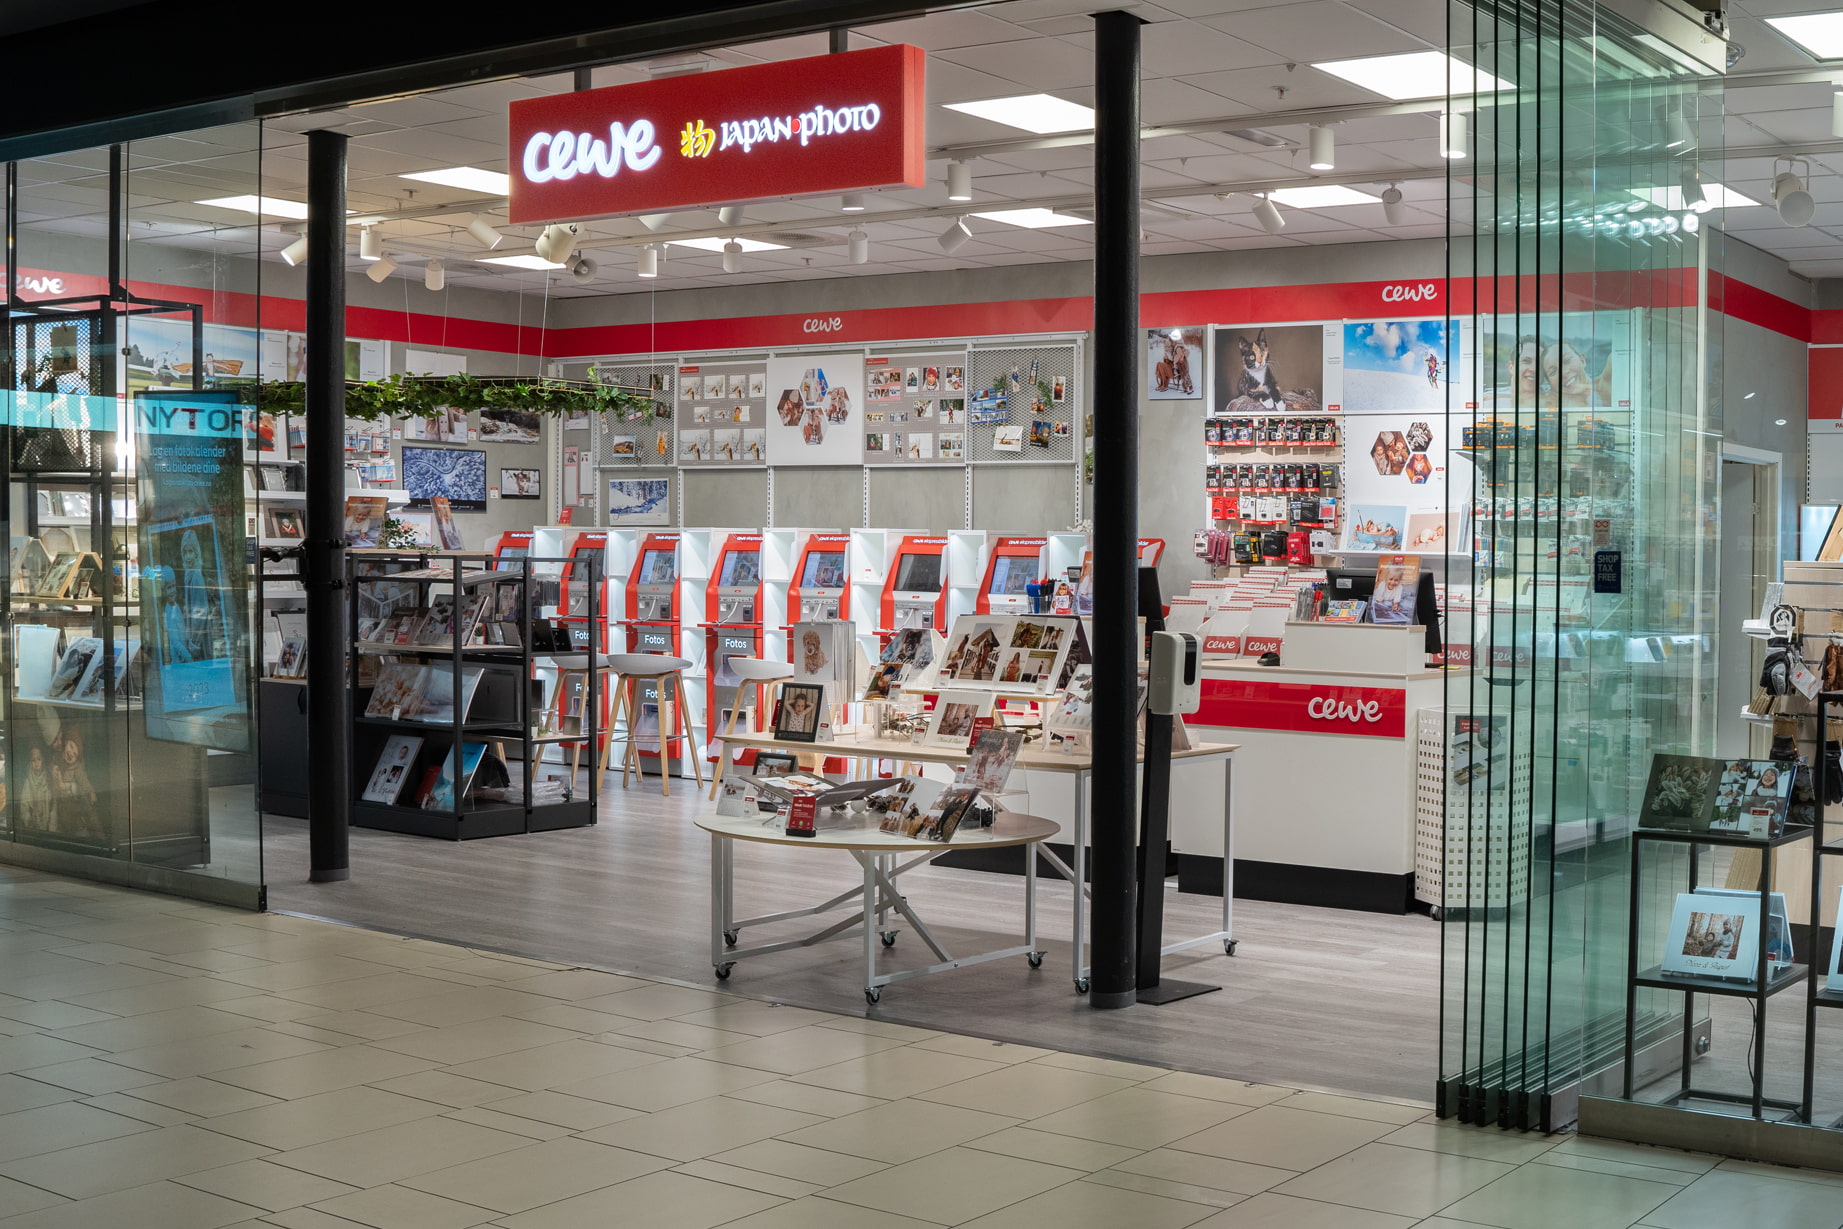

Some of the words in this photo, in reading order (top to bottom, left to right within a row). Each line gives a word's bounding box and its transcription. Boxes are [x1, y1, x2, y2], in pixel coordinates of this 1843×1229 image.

[523, 119, 662, 184] cewe
[1382, 283, 1438, 303] cewe
[803, 316, 843, 333] cewe
[164, 447, 172, 457] en
[175, 445, 226, 458] fotokalender
[155, 462, 170, 473] med
[173, 461, 201, 474] bildene
[203, 462, 221, 475] dine
[1597, 554, 1619, 563] SHOP
[1598, 564, 1613, 572] TAX
[1597, 573, 1616, 581] FREE
[575, 631, 589, 640] Foto
[644, 634, 665, 645] Fotos
[725, 638, 747, 649] Fotos
[1206, 639, 1236, 650] cewe
[1248, 640, 1278, 652] cewe
[645, 688, 667, 699] Fots
[1308, 697, 1382, 722] cewe
